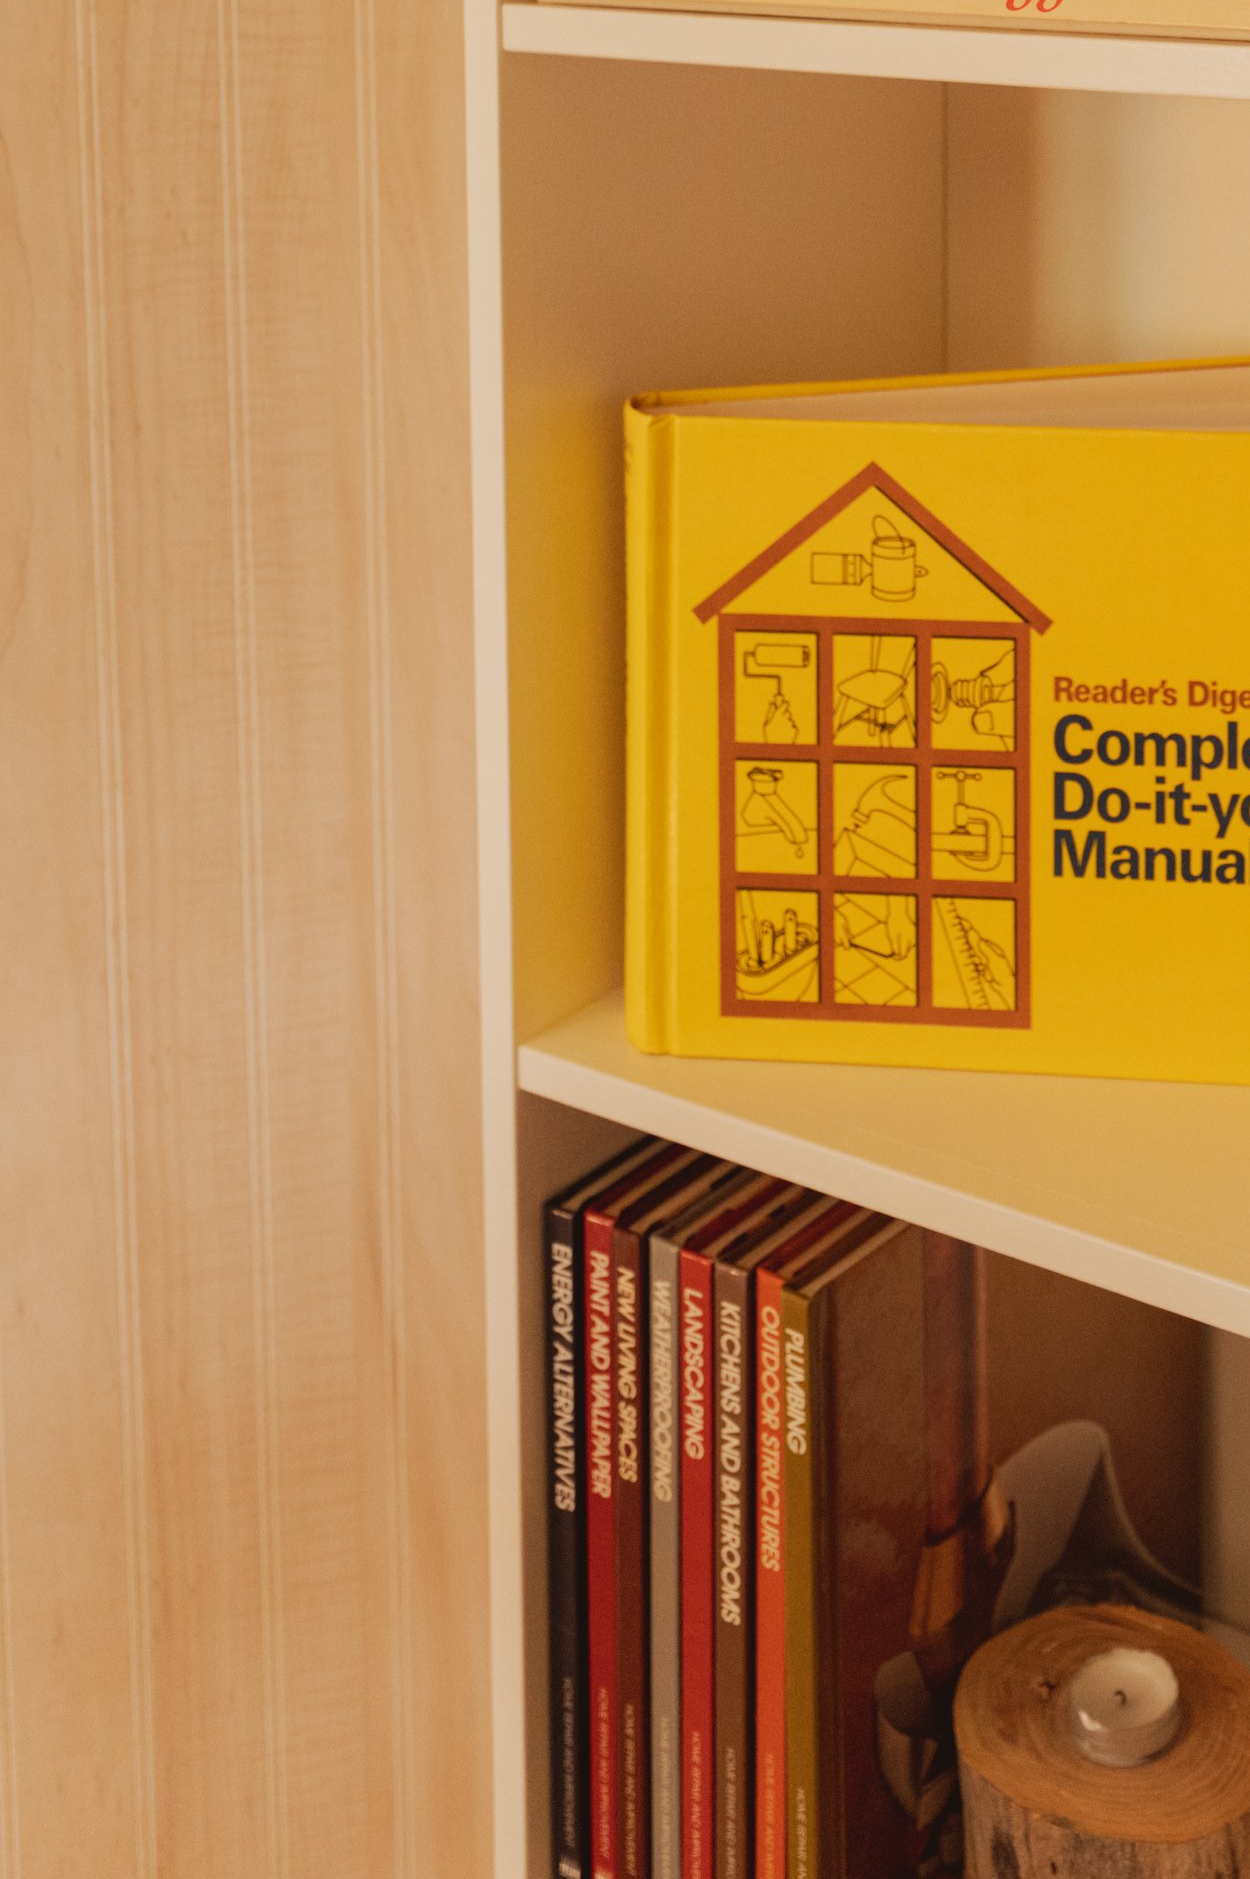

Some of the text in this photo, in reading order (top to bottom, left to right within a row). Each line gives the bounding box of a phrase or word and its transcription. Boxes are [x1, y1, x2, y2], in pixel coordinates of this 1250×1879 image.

[1053, 676, 1178, 707] Reader's
[552, 1242, 576, 1513] ENERGY ALTERNATIVES
[590, 1250, 612, 1500] PAINT AND WALLPAPER
[617, 1266, 638, 1483] NEW LIVING SPACES
[653, 1281, 673, 1503] WEATHERPROOFING
[683, 1287, 704, 1461] LANDSCAPING
[719, 1300, 742, 1626] KITCHENS AND BATHROOMS
[760, 1305, 781, 1573] OUTDOOR STRUCTURES
[784, 1326, 807, 1456] PLUMBING
